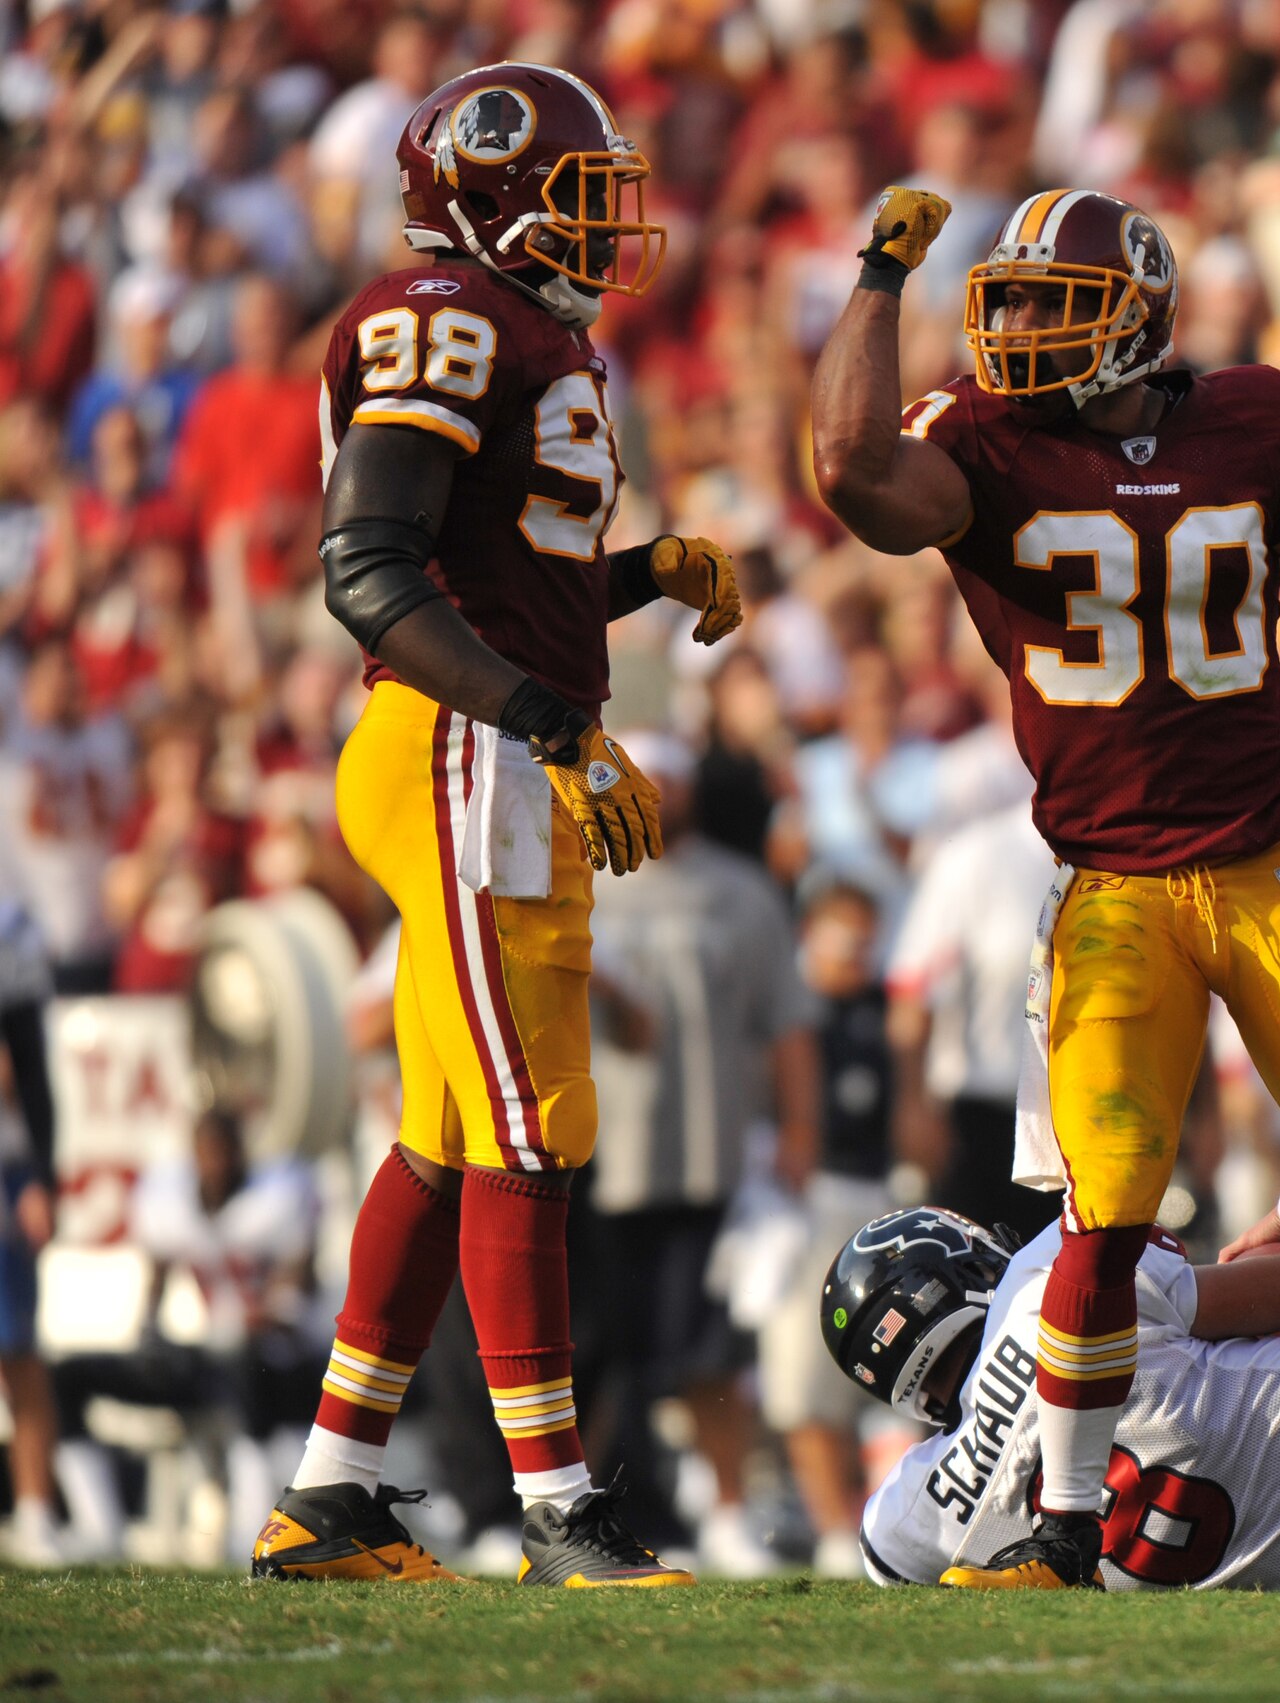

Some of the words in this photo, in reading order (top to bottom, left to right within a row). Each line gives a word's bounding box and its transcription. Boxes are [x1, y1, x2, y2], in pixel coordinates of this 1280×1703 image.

[358, 307, 497, 400] 98
[517, 371, 624, 563] 9
[1116, 483, 1181, 496] REDSKINS
[1012, 501, 1270, 707] 30
[897, 1345, 934, 1403] TEXANS
[926, 1334, 1037, 1525] SCHAUB
[1026, 1443, 1235, 1585] 8
